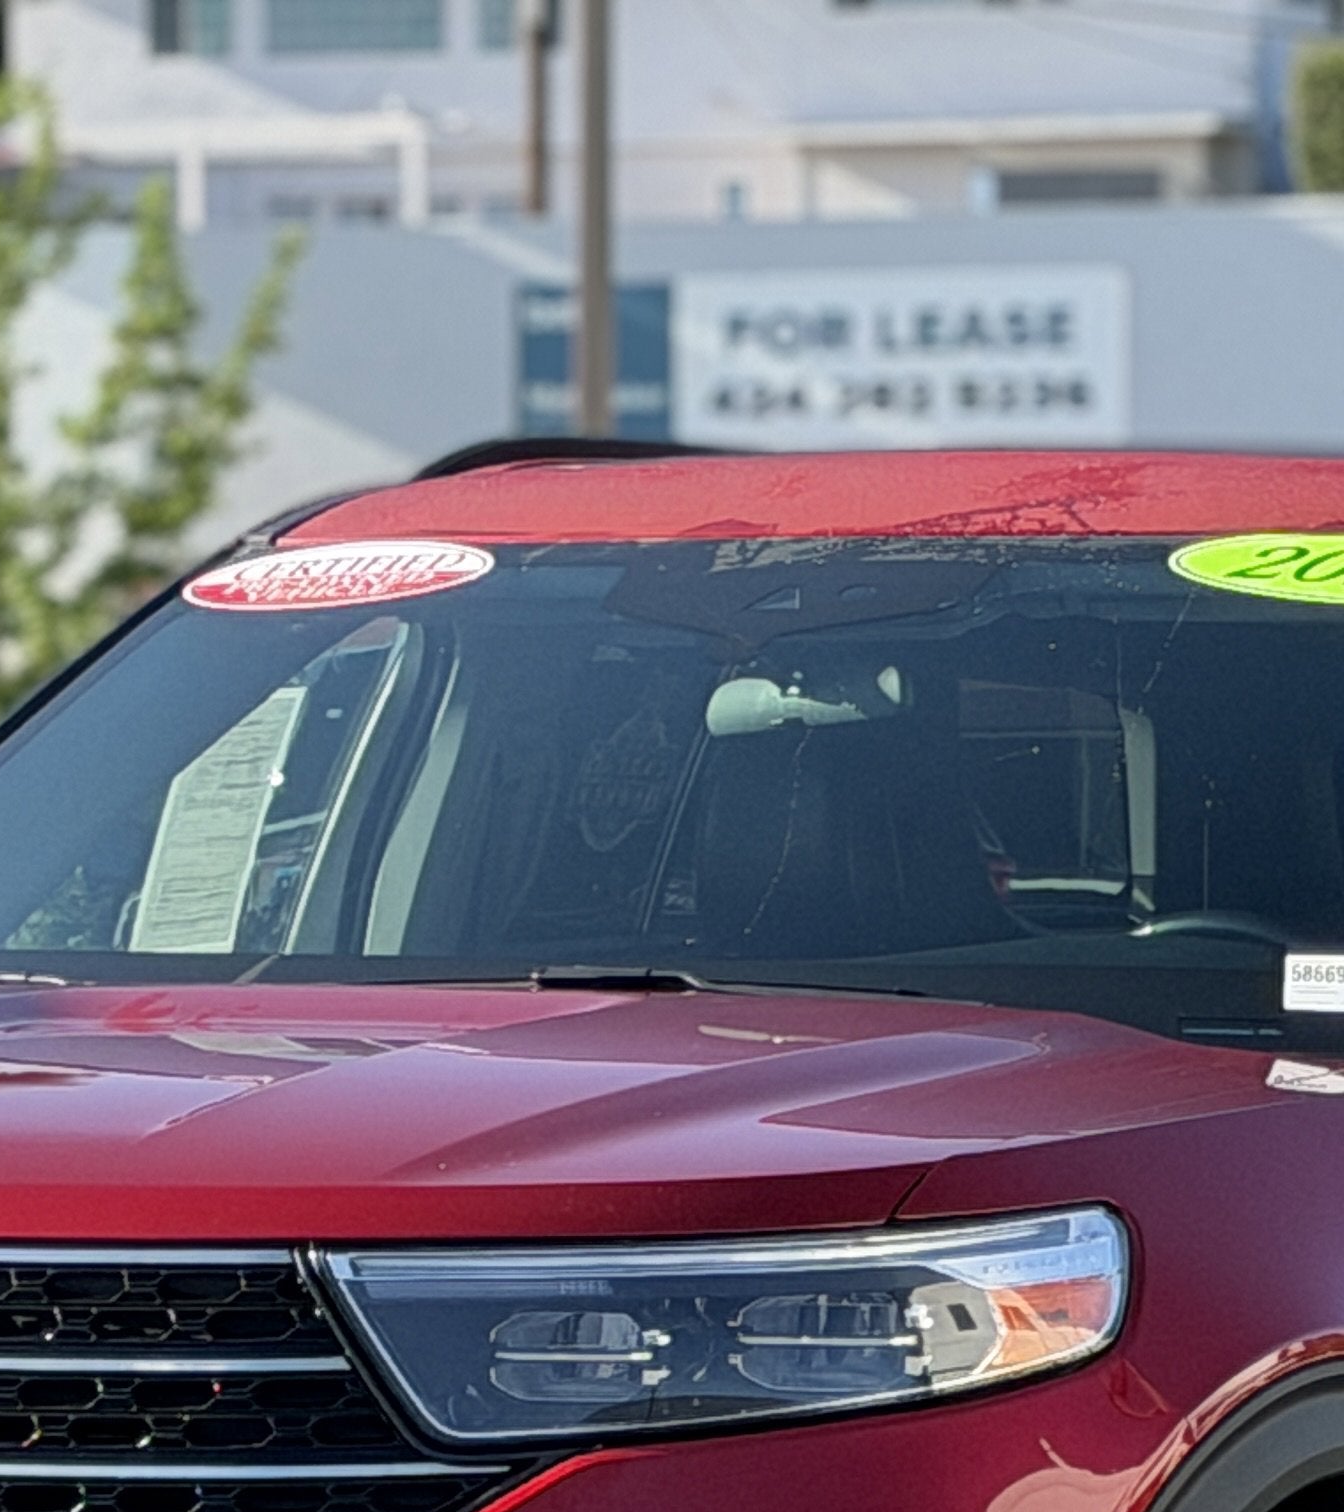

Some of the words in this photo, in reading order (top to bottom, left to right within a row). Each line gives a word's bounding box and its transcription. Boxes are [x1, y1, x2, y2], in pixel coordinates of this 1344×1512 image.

[722, 306, 855, 358] FOR
[872, 304, 1074, 355] LEASE
[233, 552, 467, 584] CERTIFIED
